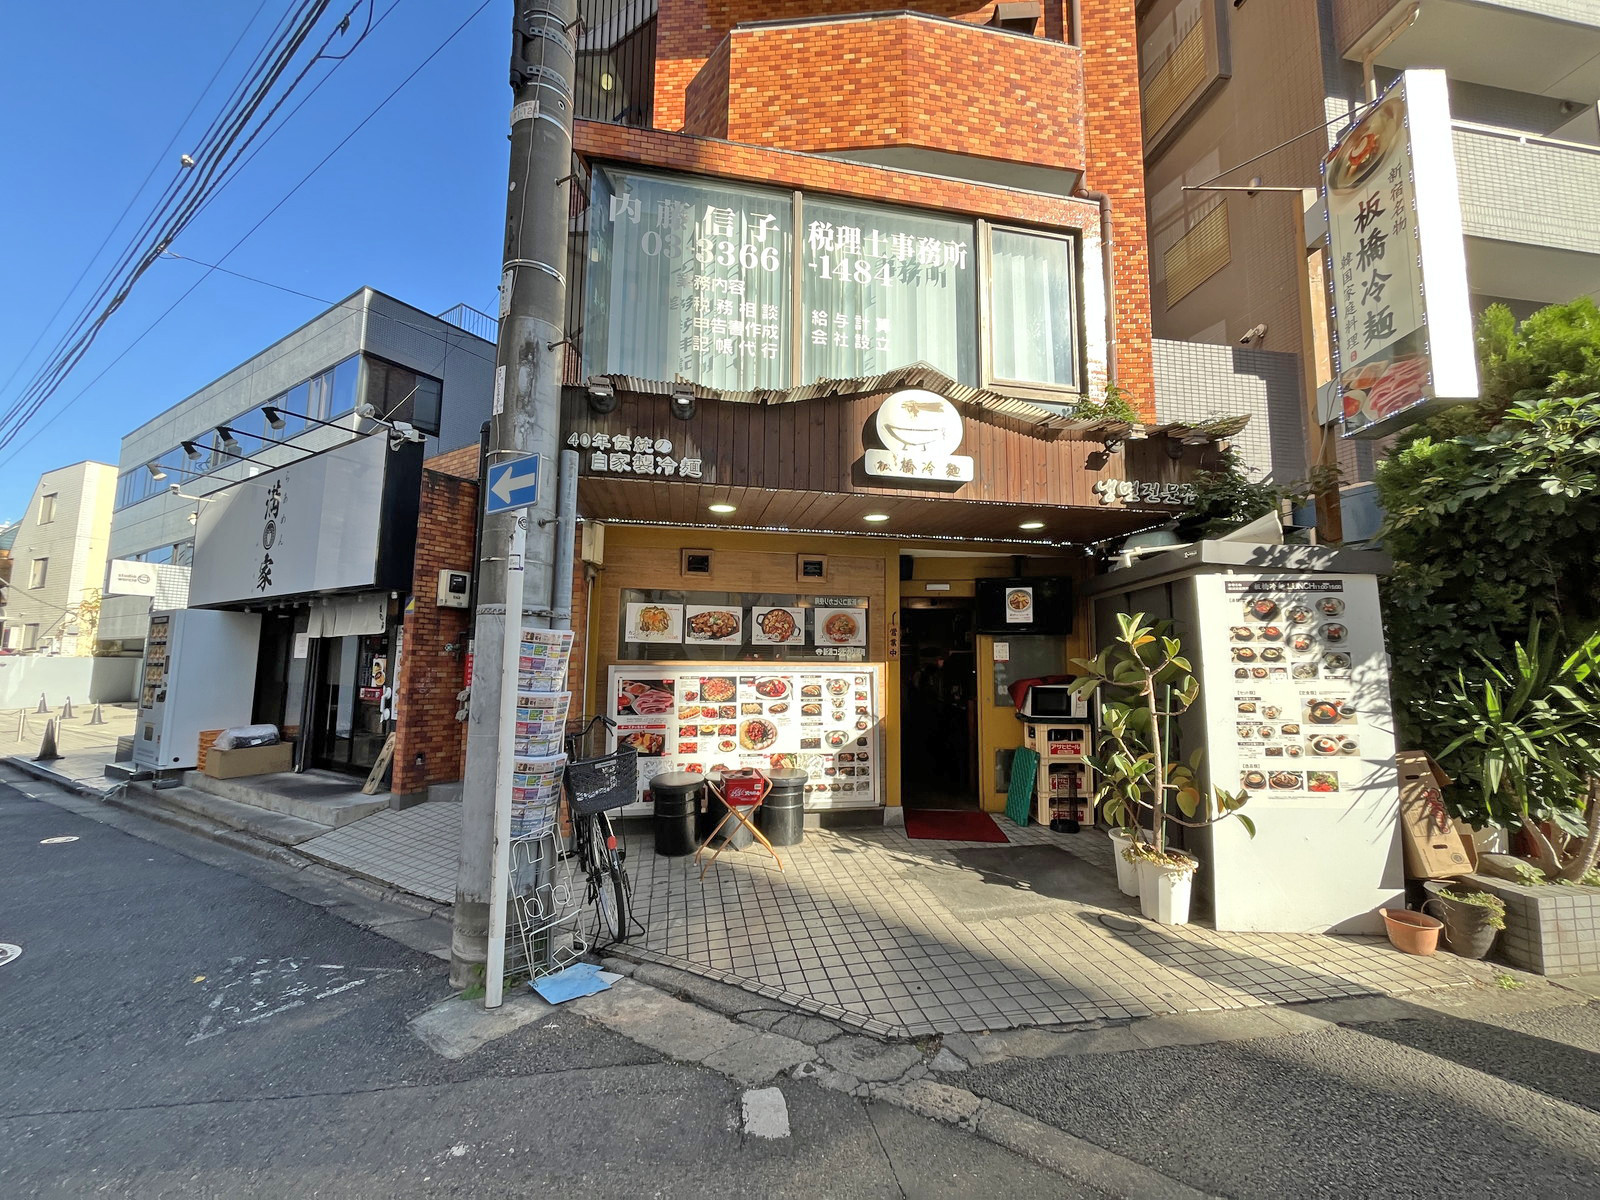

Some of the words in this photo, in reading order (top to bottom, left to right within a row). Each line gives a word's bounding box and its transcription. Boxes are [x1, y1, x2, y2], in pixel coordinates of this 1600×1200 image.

[1387, 162, 1407, 241] 新宿名物
[609, 193, 780, 242] 内藤信子
[808, 220, 968, 270] 税理士事務所
[1354, 190, 1397, 350] 板橋冷麺
[693, 296, 779, 321] 税務相談
[1340, 251, 1360, 351] 韓国家庭料理
[693, 317, 779, 340] 申告書作成
[811, 329, 890, 352] 会社設立
[692, 335, 779, 360] 記帳代行
[567, 432, 673, 454] 40年伝統の
[591, 451, 703, 478] 自家製冷麺
[1287, 582, 1315, 590] LUNCH
